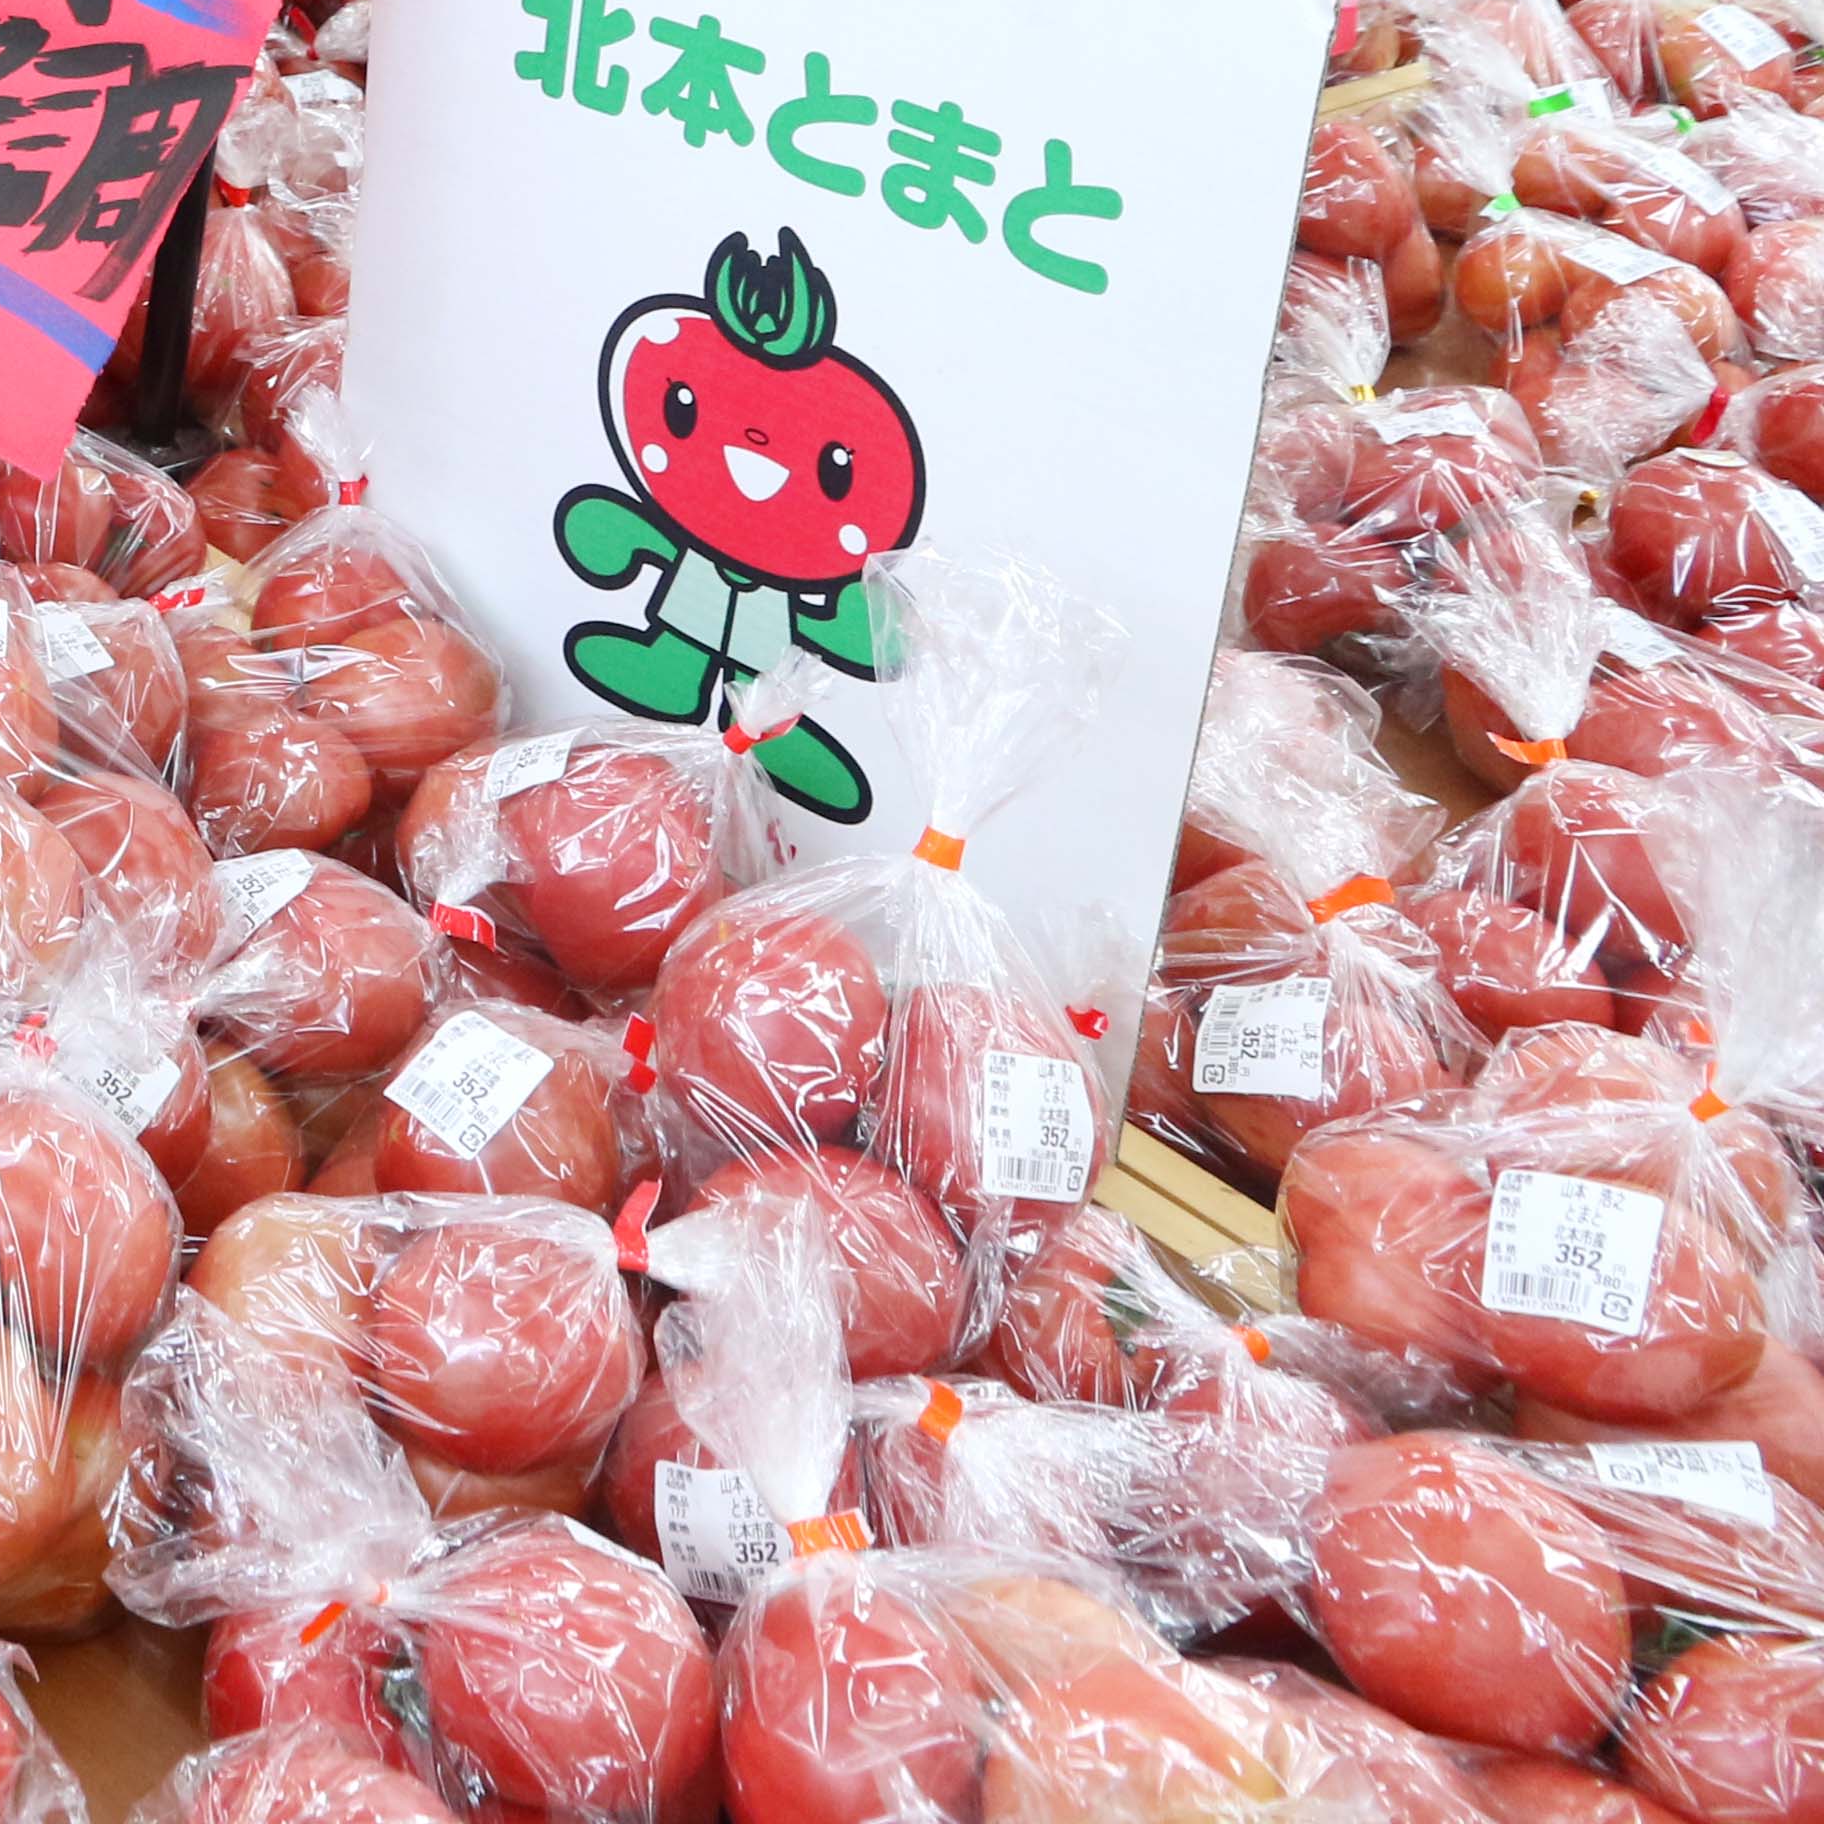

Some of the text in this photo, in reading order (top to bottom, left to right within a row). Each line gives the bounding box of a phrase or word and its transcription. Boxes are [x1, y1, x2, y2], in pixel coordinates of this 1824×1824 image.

[234, 872, 266, 899] 352
[1241, 1026, 1262, 1060] 352
[96, 1069, 133, 1106] 352
[452, 1070, 489, 1106] 352
[1039, 1125, 1070, 1149] 352
[1560, 1181, 1588, 1200] 山本
[1564, 1203, 1603, 1228] とまと
[1553, 1223, 1607, 1249] 北本市産
[1554, 1242, 1604, 1273] 352
[1592, 1271, 1622, 1290] 380
[719, 1473, 744, 1495] 山本
[732, 1495, 767, 1519] とまと
[728, 1521, 776, 1541] 北本市産
[734, 1541, 779, 1564] 352
